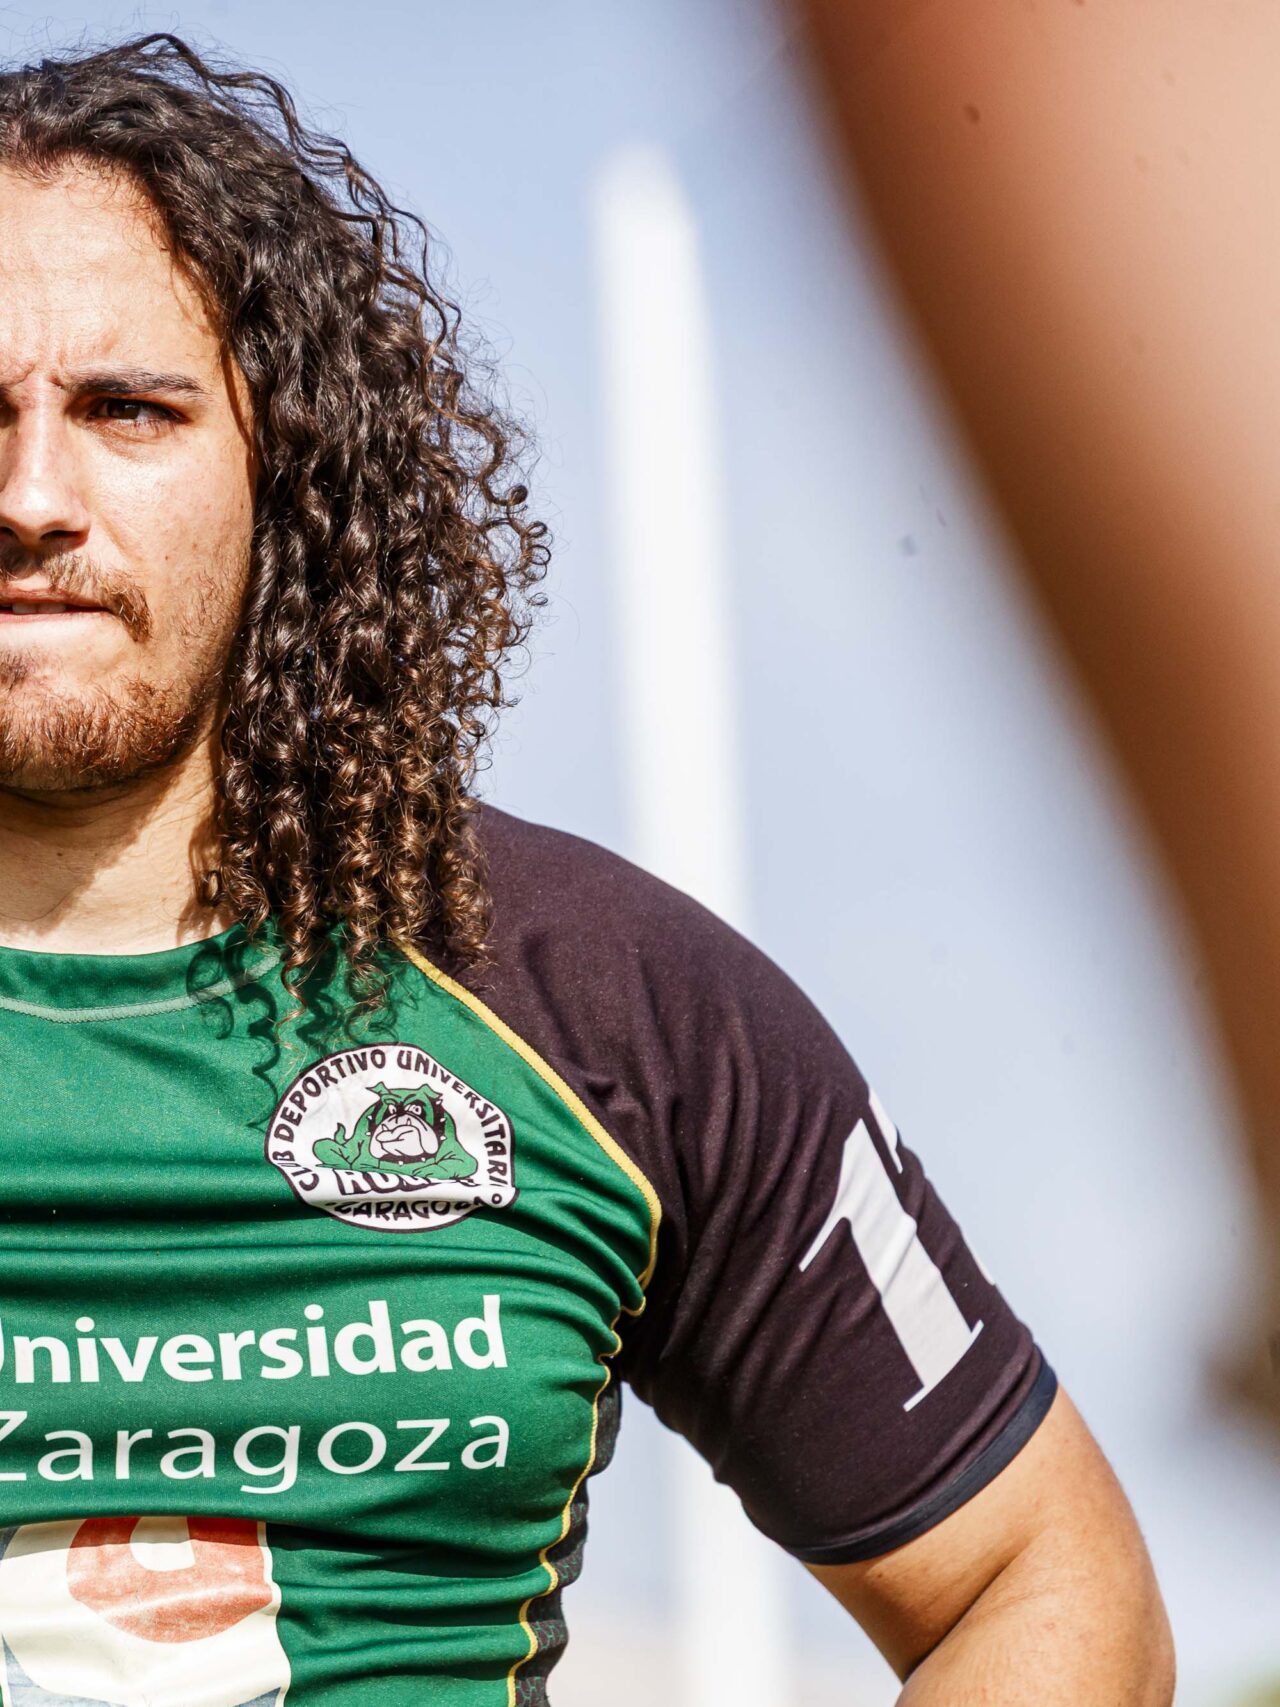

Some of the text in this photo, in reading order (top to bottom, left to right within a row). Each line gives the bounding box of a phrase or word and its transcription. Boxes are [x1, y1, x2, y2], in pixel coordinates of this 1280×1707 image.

[273, 1049, 386, 1143] DEPORTIVO
[396, 1050, 509, 1188] UNIVERSITARI
[798, 1088, 996, 1413] 1
